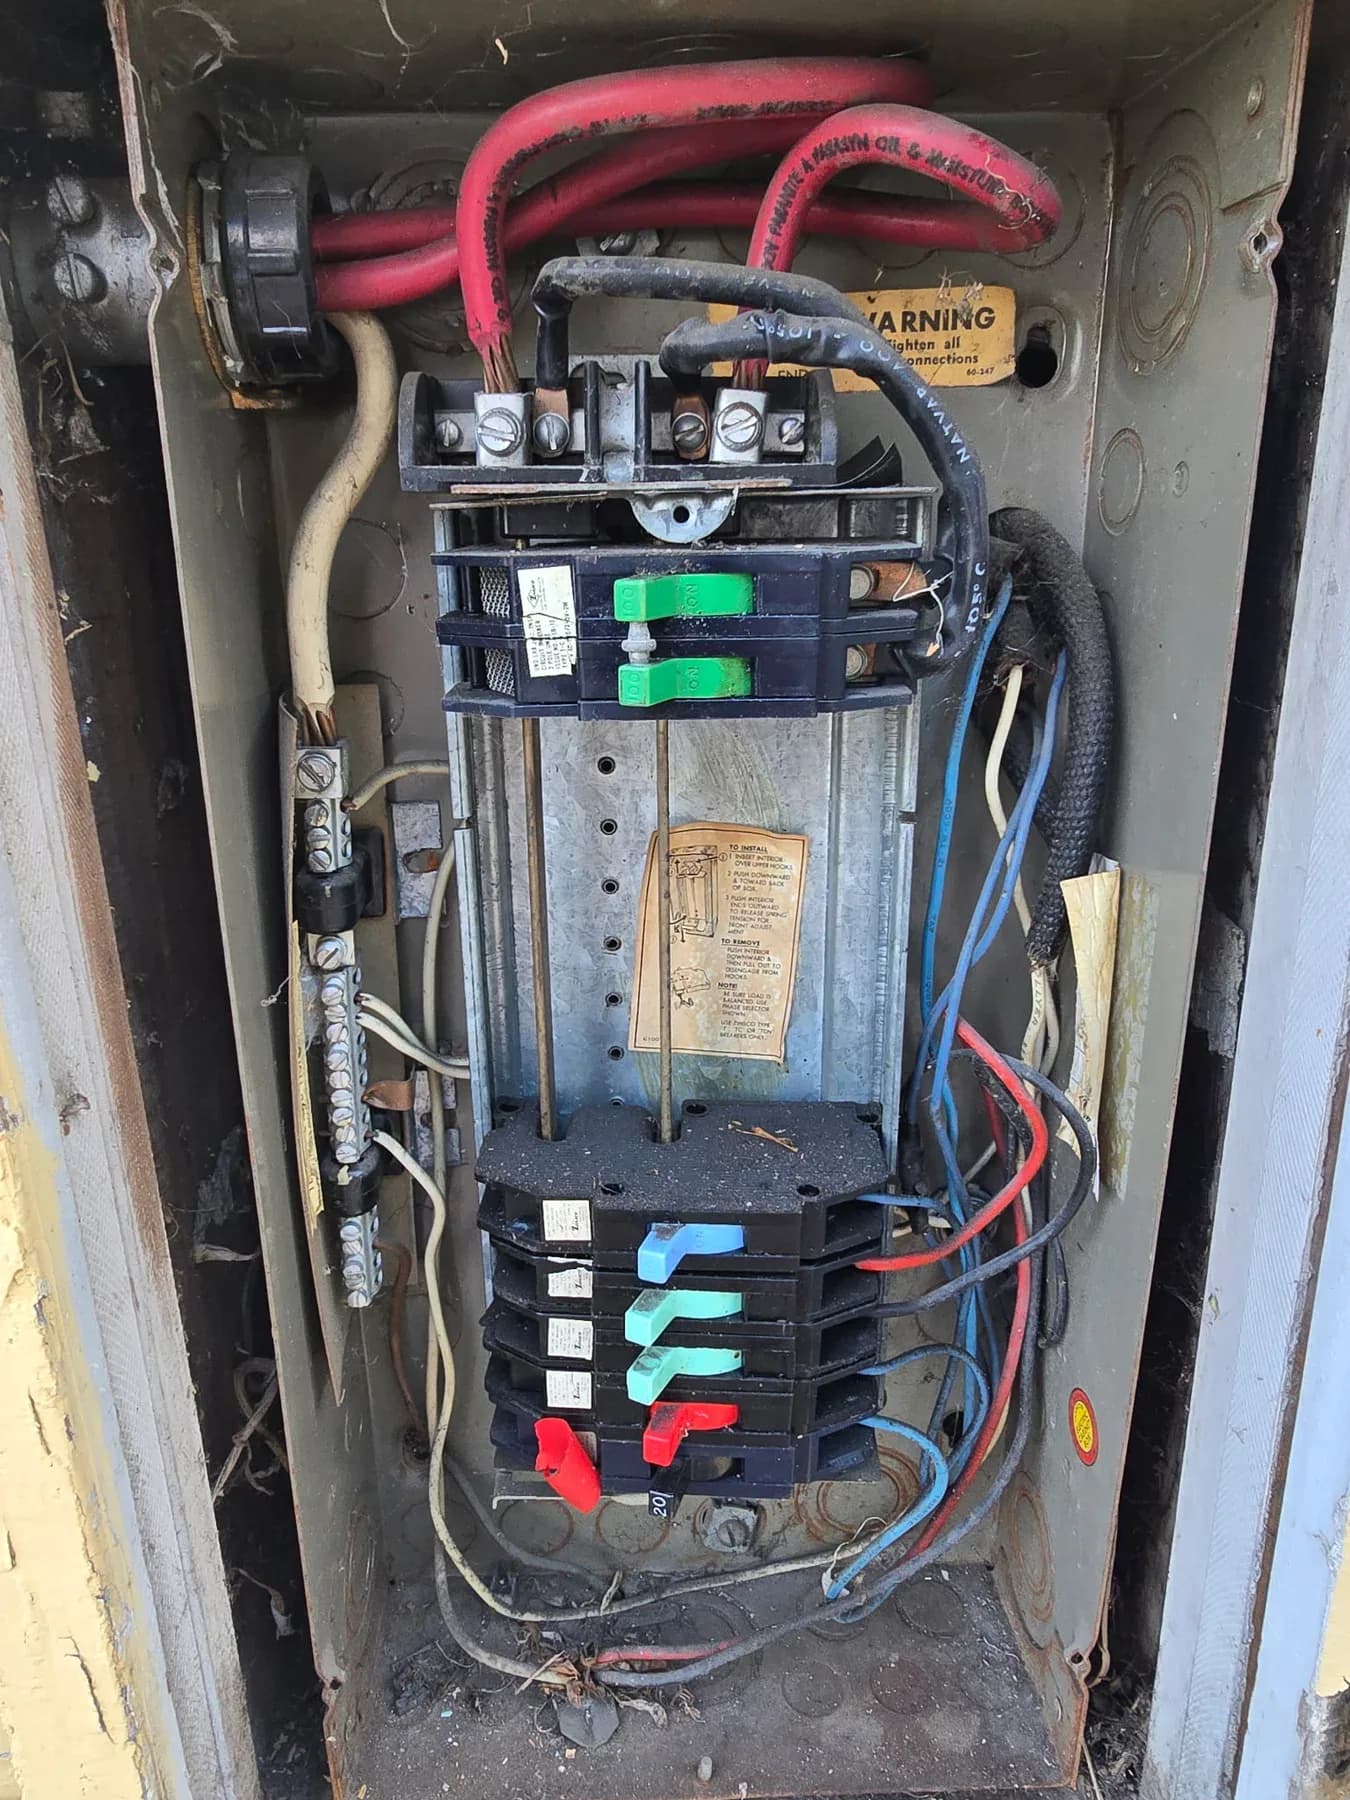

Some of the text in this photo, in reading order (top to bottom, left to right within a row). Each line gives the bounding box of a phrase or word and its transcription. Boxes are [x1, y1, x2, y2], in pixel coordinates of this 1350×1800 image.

[868, 306, 996, 334] ARNING
[889, 336, 961, 354] ighten all
[905, 353, 979, 366] onnections
[686, 584, 698, 608] ON
[628, 672, 640, 703] 100
[688, 666, 699, 690] ON
[751, 872, 791, 880] DOWNWARD
[652, 1496, 667, 1517] 20
